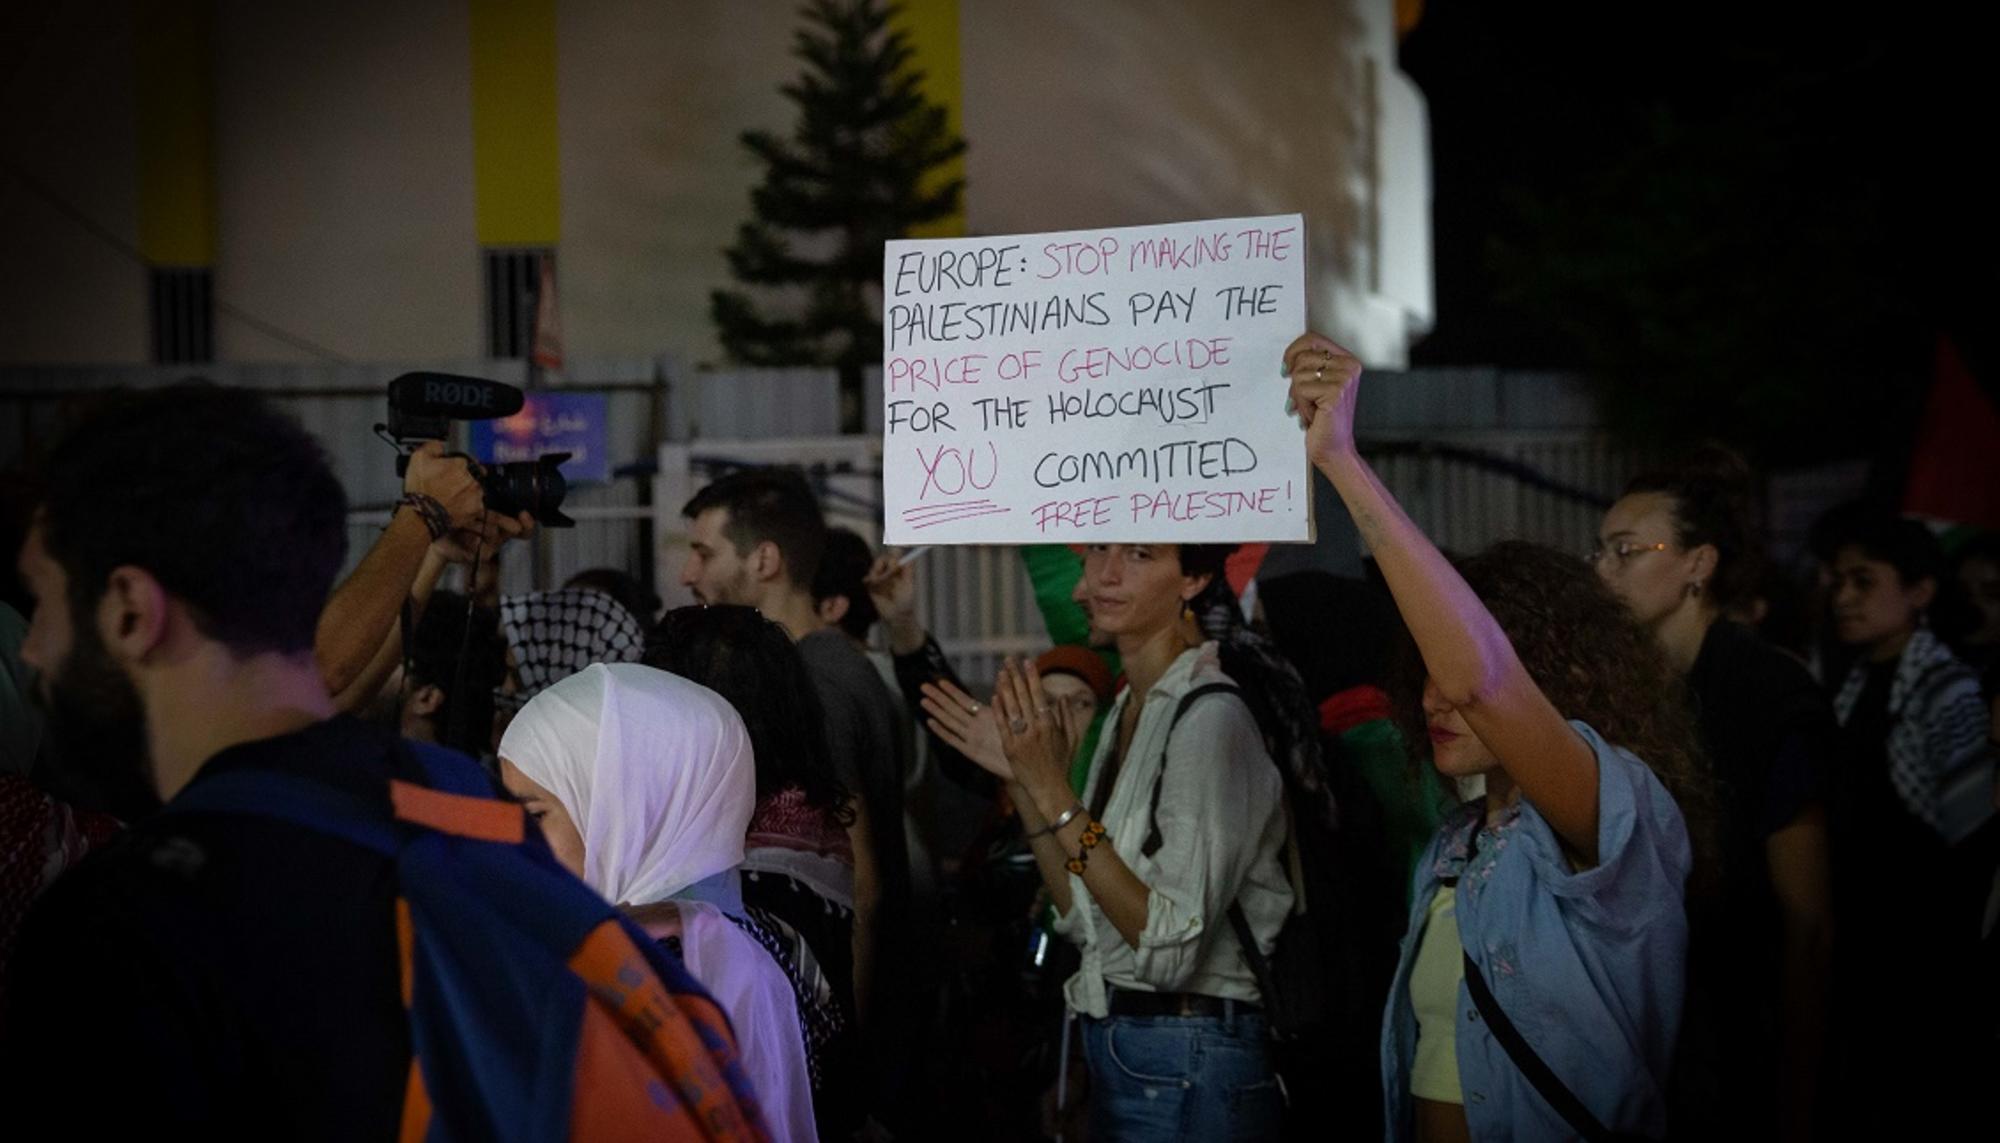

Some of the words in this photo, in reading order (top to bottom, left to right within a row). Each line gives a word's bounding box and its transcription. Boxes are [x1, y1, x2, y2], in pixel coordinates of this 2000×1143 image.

[894, 245, 1028, 296] EUROPE:
[1037, 237, 1120, 279] STOP
[1129, 232, 1232, 272] MAKING
[1236, 227, 1297, 261] THE
[889, 292, 1111, 351] PALESTINIANS
[1128, 287, 1198, 326] PAY
[1216, 285, 1283, 320] THE
[888, 355, 988, 392] PRICE
[997, 350, 1042, 381] OF
[1058, 337, 1234, 383] GENOCIDE
[423, 380, 497, 408] RØDE
[888, 401, 956, 434] FOR
[972, 396, 1030, 431] THE
[1048, 384, 1231, 424] HOLOCAUST
[916, 441, 999, 499] YOU
[1034, 437, 1258, 487] COMMITTED
[1031, 495, 1119, 532] FREE
